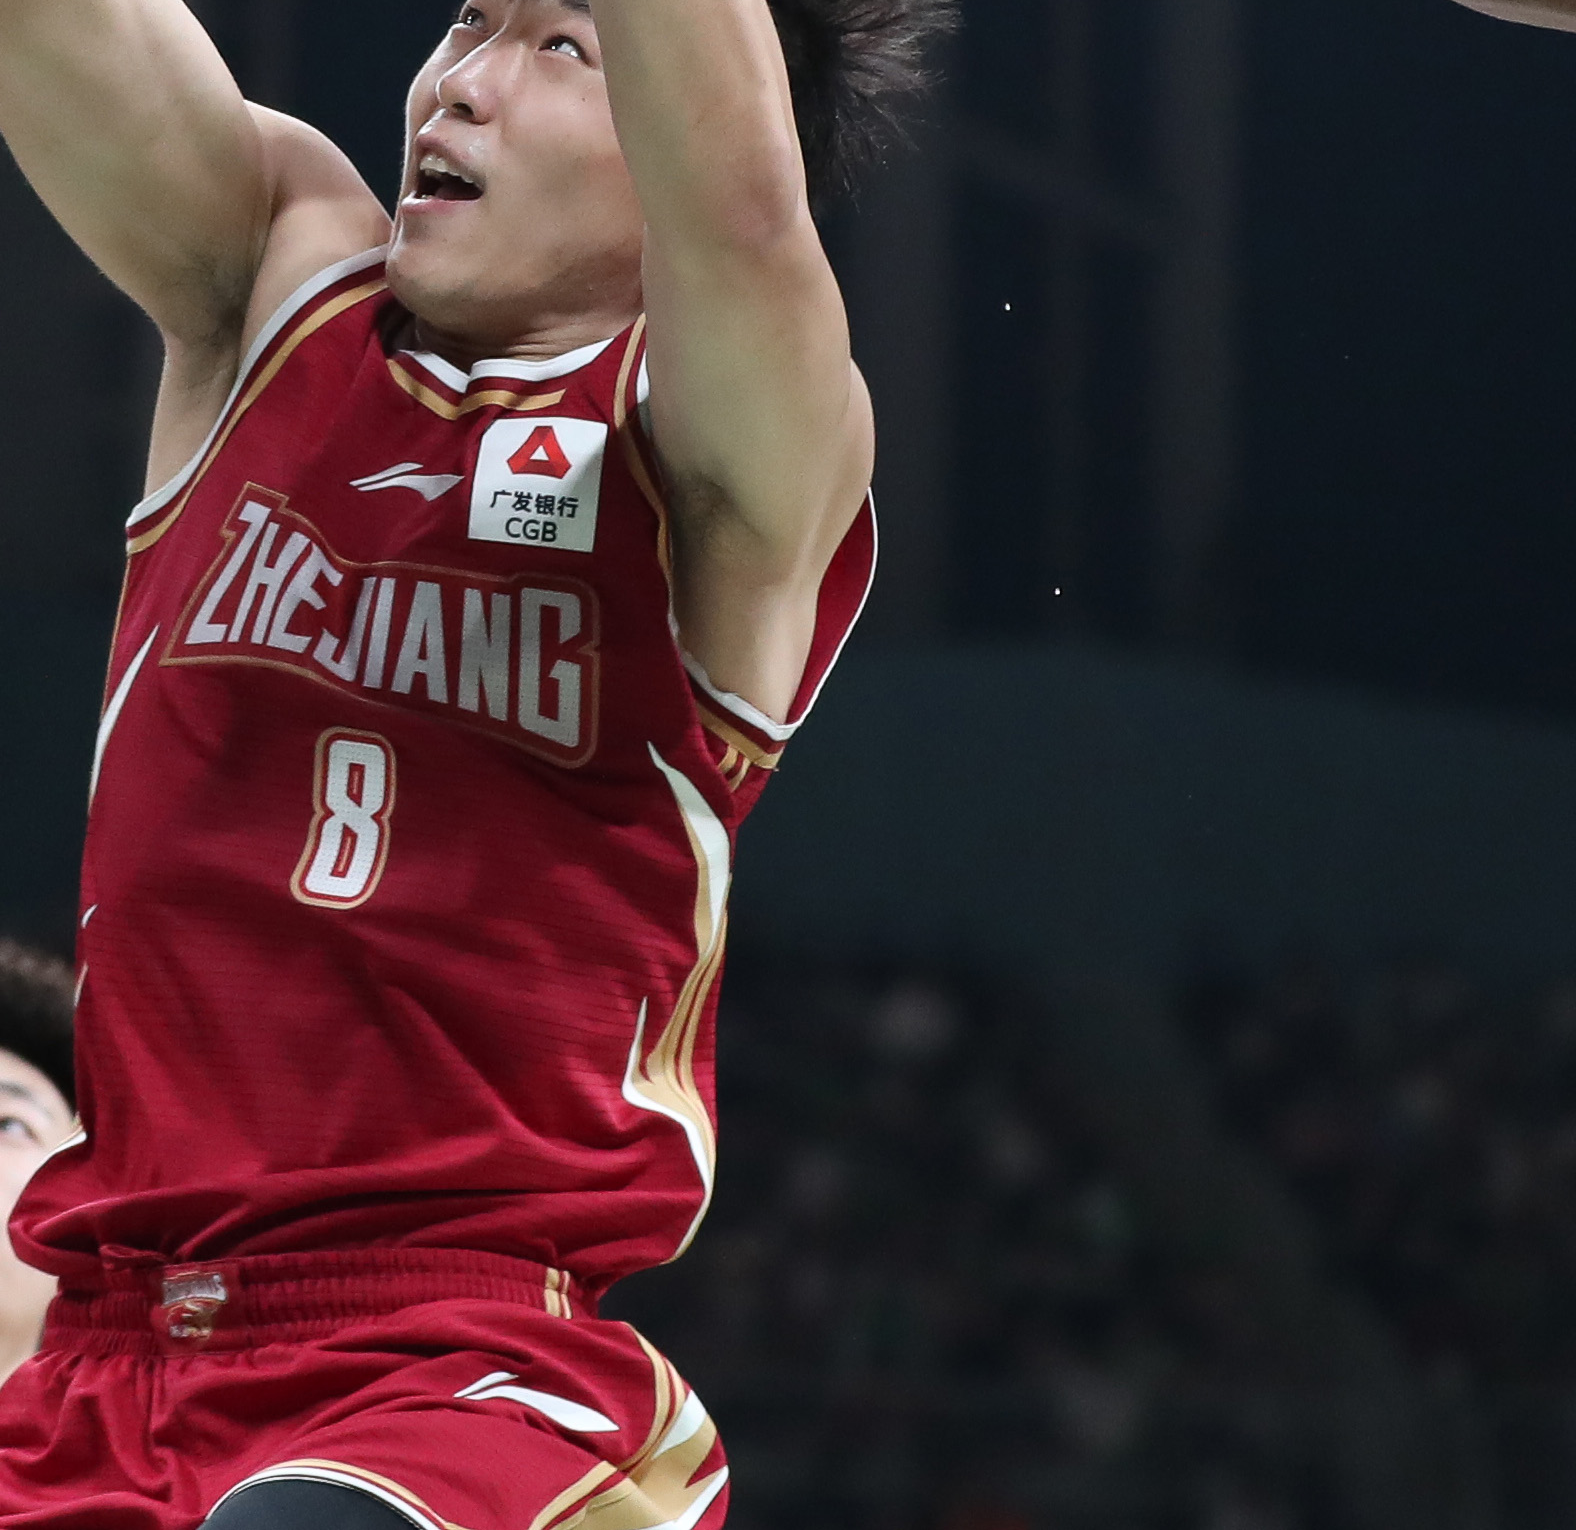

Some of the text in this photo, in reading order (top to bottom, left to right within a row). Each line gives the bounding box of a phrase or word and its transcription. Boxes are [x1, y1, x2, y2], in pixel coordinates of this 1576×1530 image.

[489, 489, 579, 518] 广发银行
[505, 517, 557, 542] CGB
[185, 501, 582, 748] ZHEJIANG
[296, 732, 394, 904] 8
